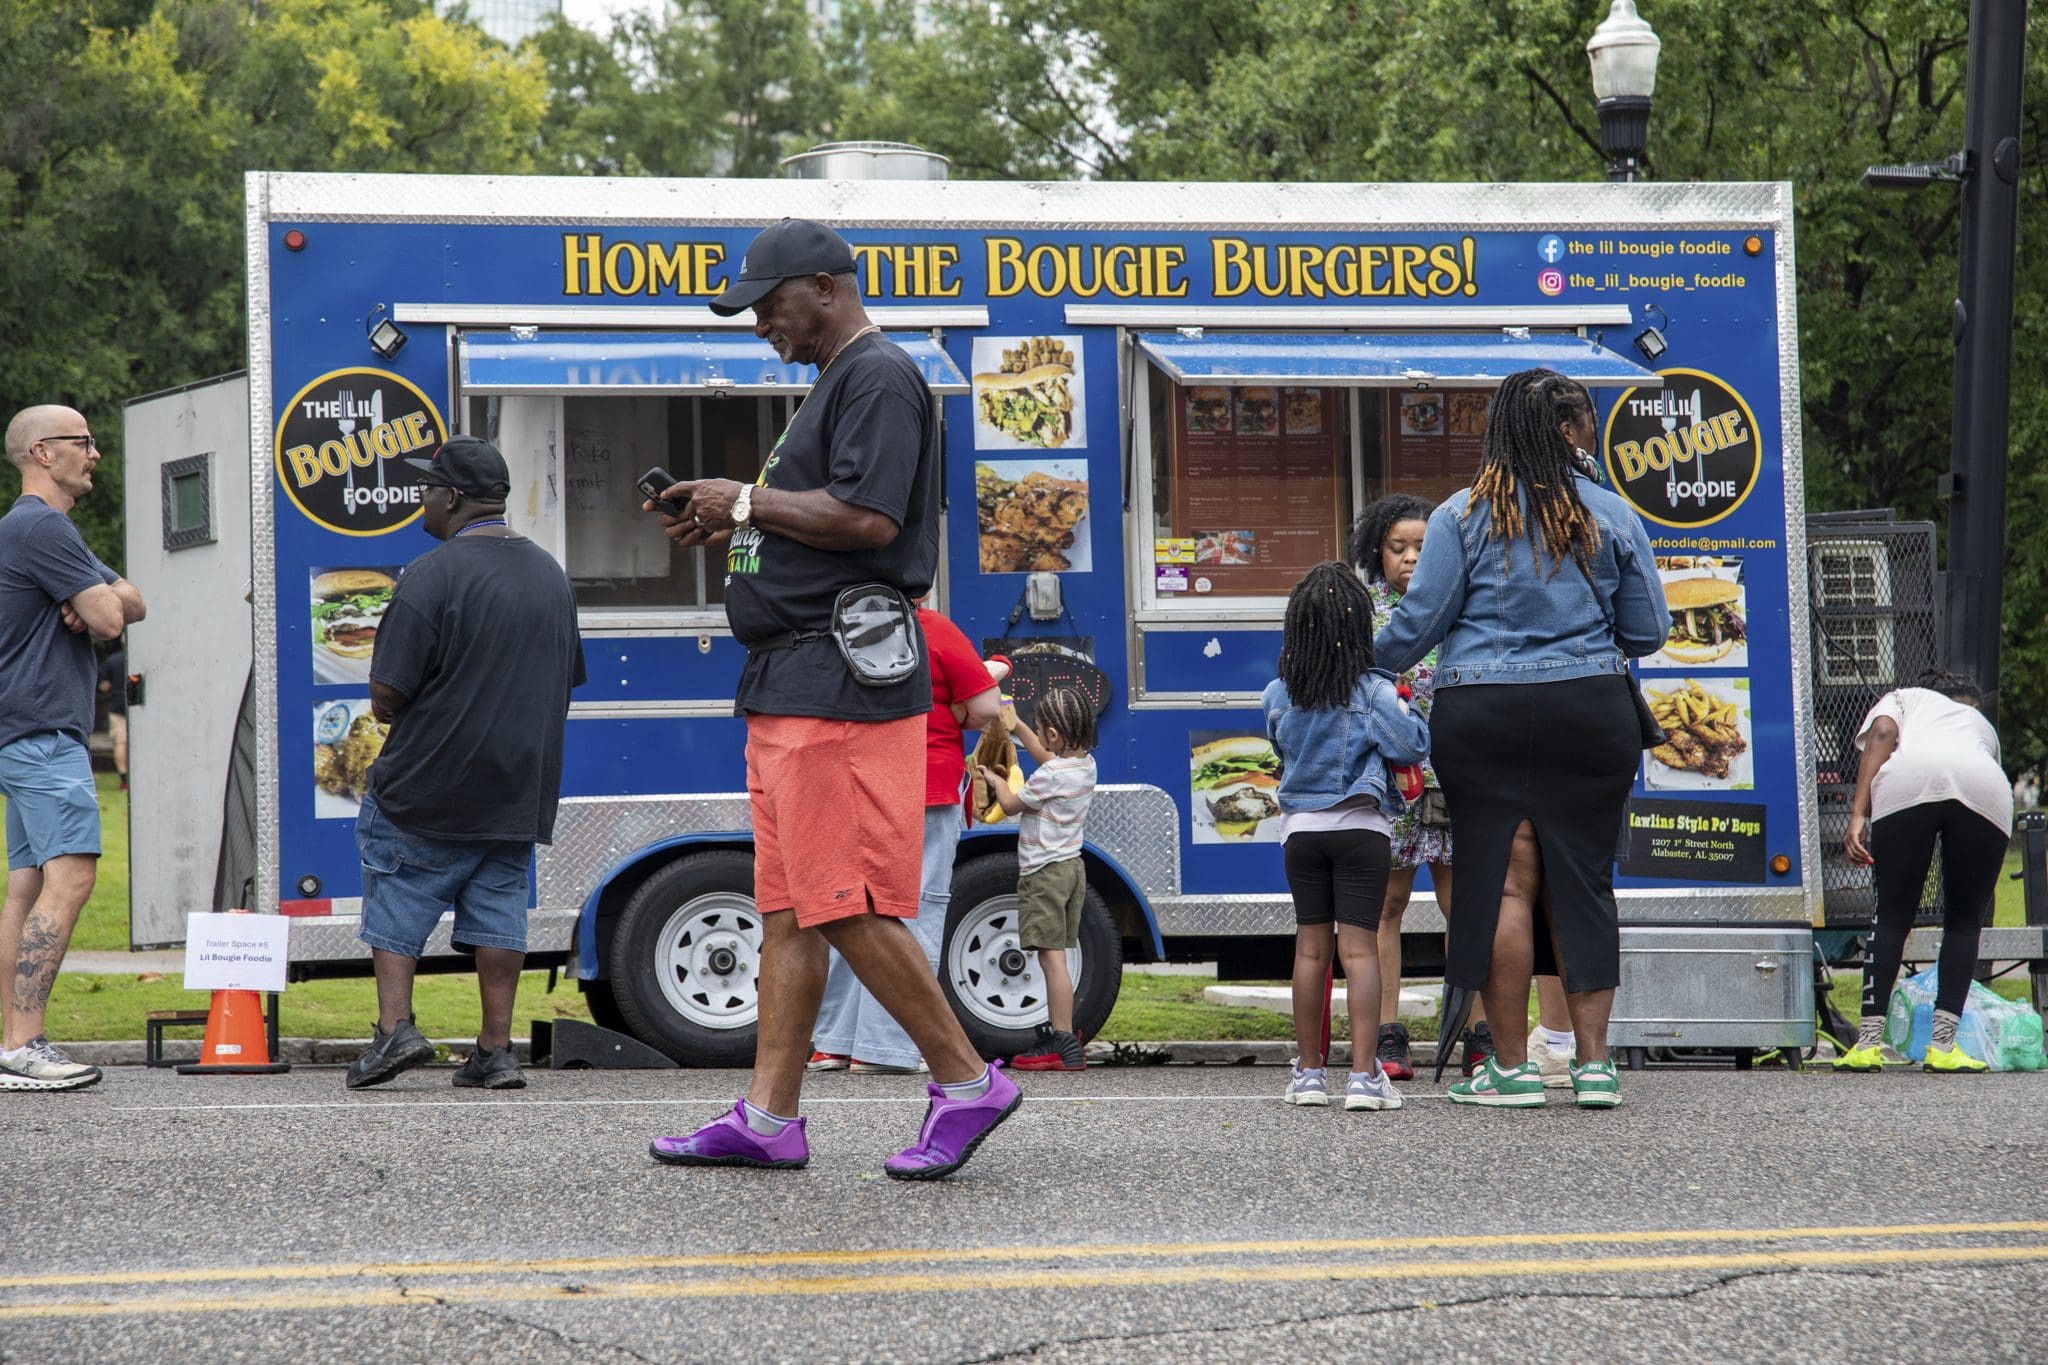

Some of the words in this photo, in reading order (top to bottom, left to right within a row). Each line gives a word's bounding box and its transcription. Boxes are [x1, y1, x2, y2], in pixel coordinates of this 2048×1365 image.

[1568, 240, 1594, 254] the
[1599, 240, 1614, 254] lil
[1619, 240, 1674, 258] bougie
[1679, 240, 1731, 254] foodie
[562, 232, 728, 297] HOME
[854, 244, 962, 297] THE
[984, 236, 1190, 299] BOUGIE
[1210, 235, 1478, 299] BURGERS!
[1569, 273, 1746, 291] the_lil_bougie_foodie
[302, 401, 340, 419] THE
[347, 400, 375, 418] LIL
[1629, 400, 1663, 417] THE
[1669, 399, 1694, 416] LIL
[286, 410, 434, 489] BOUGIE
[1614, 409, 1749, 482] BOUGIE
[343, 486, 421, 505] FOODIE
[1666, 481, 1736, 498] FOODIE
[1650, 537, 1776, 551] efoodie@gmail.com
[1677, 815, 1708, 834] Style
[1711, 816, 1730, 832] Po'
[1732, 818, 1761, 837] Boys
[1651, 838, 1671, 847] 1207
[1685, 839, 1709, 848] Street
[1710, 840, 1734, 849] North
[1651, 848, 1691, 859] Alabaster,
[1695, 851, 1707, 859] AL
[1708, 852, 1734, 861] 35007
[206, 940, 229, 948] Trailer
[232, 940, 257, 949] Space
[200, 953, 210, 961] Lil
[212, 953, 241, 962] Bougie
[243, 954, 272, 962] Foodie
